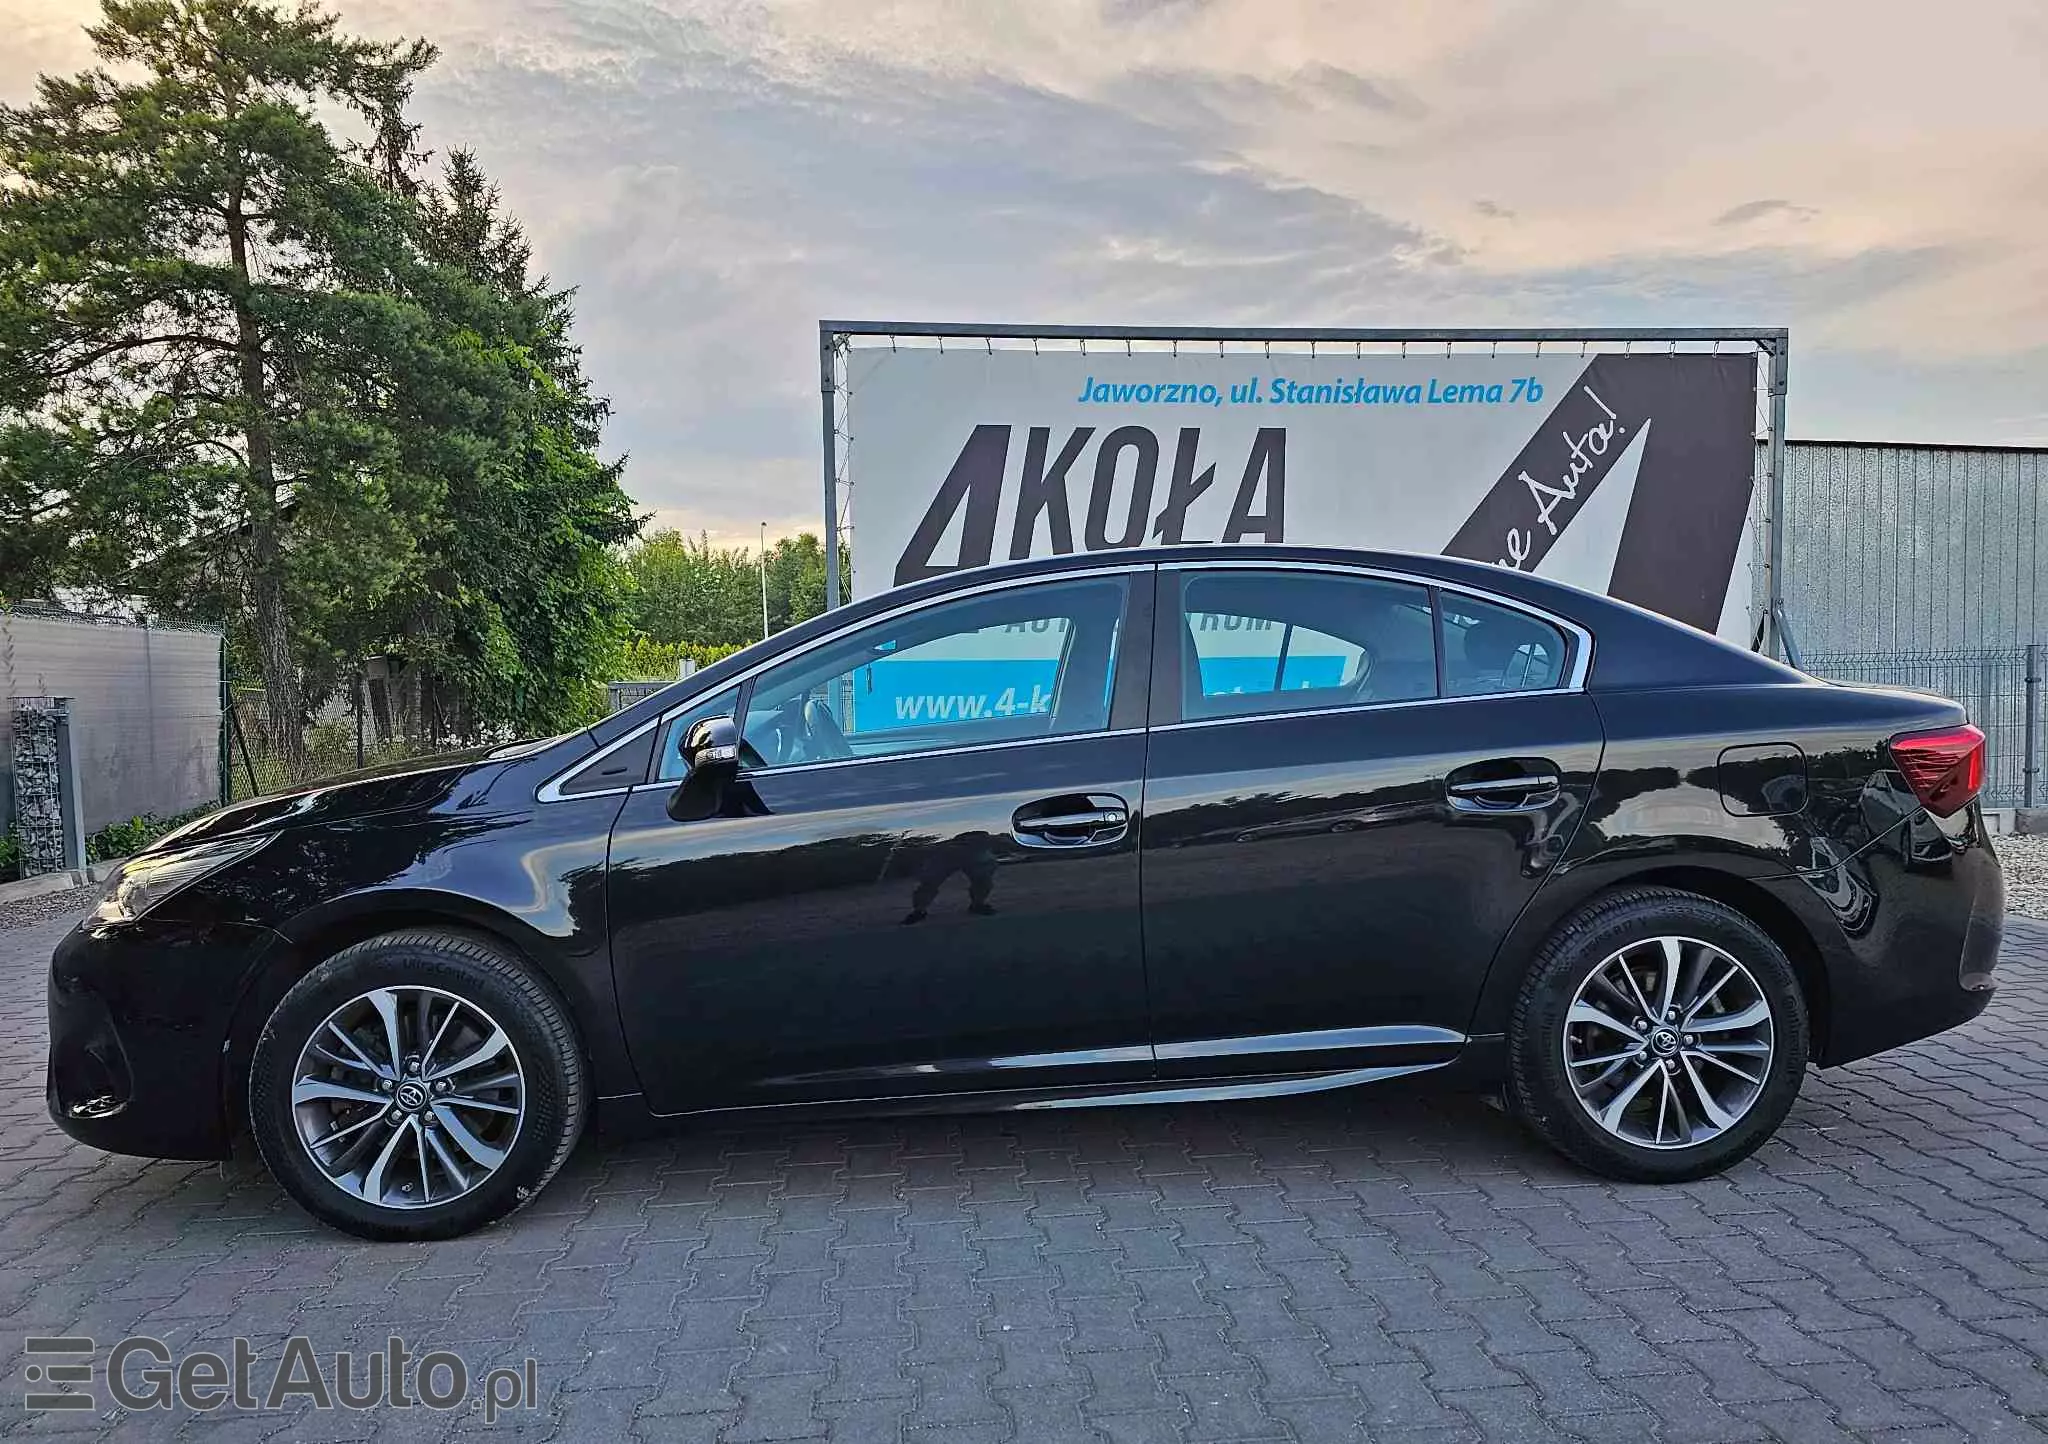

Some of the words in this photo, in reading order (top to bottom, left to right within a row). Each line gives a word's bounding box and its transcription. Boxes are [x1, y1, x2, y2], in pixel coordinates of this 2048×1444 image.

[1078, 376, 1223, 407] Jaworzno,
[1230, 376, 1262, 404] ul.
[1269, 377, 1422, 404] Stanisława
[1427, 378, 1504, 404] Lema
[1508, 376, 1544, 404] 7b
[1517, 384, 1626, 536] Auta!
